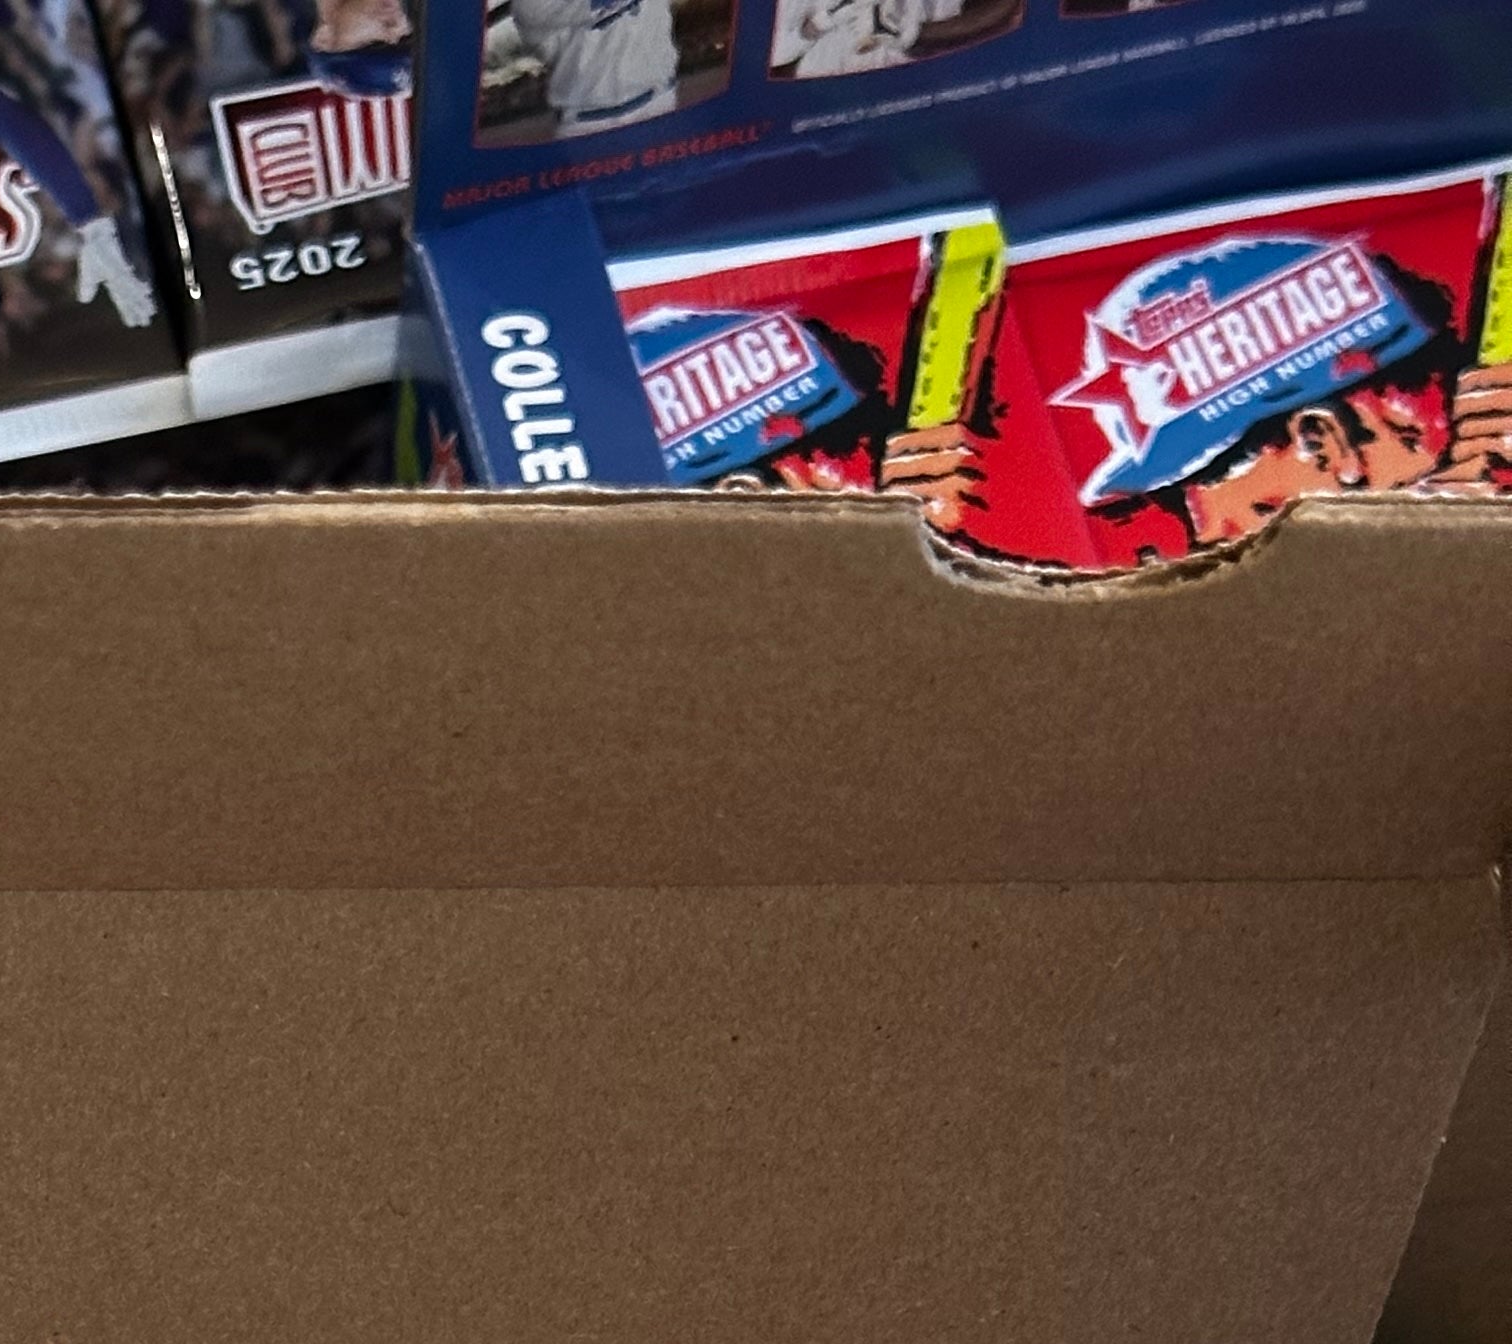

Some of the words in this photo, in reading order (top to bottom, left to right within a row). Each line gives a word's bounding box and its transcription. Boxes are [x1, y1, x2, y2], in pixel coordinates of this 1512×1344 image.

[229, 235, 368, 292] 2025
[645, 320, 803, 440] RITAGE
[1167, 250, 1371, 397] HERITAGE
[1198, 378, 1271, 423] HIGH
[1276, 312, 1388, 380] NUMBER
[481, 313, 589, 484] COLLE
[702, 376, 819, 447] NUMBER
